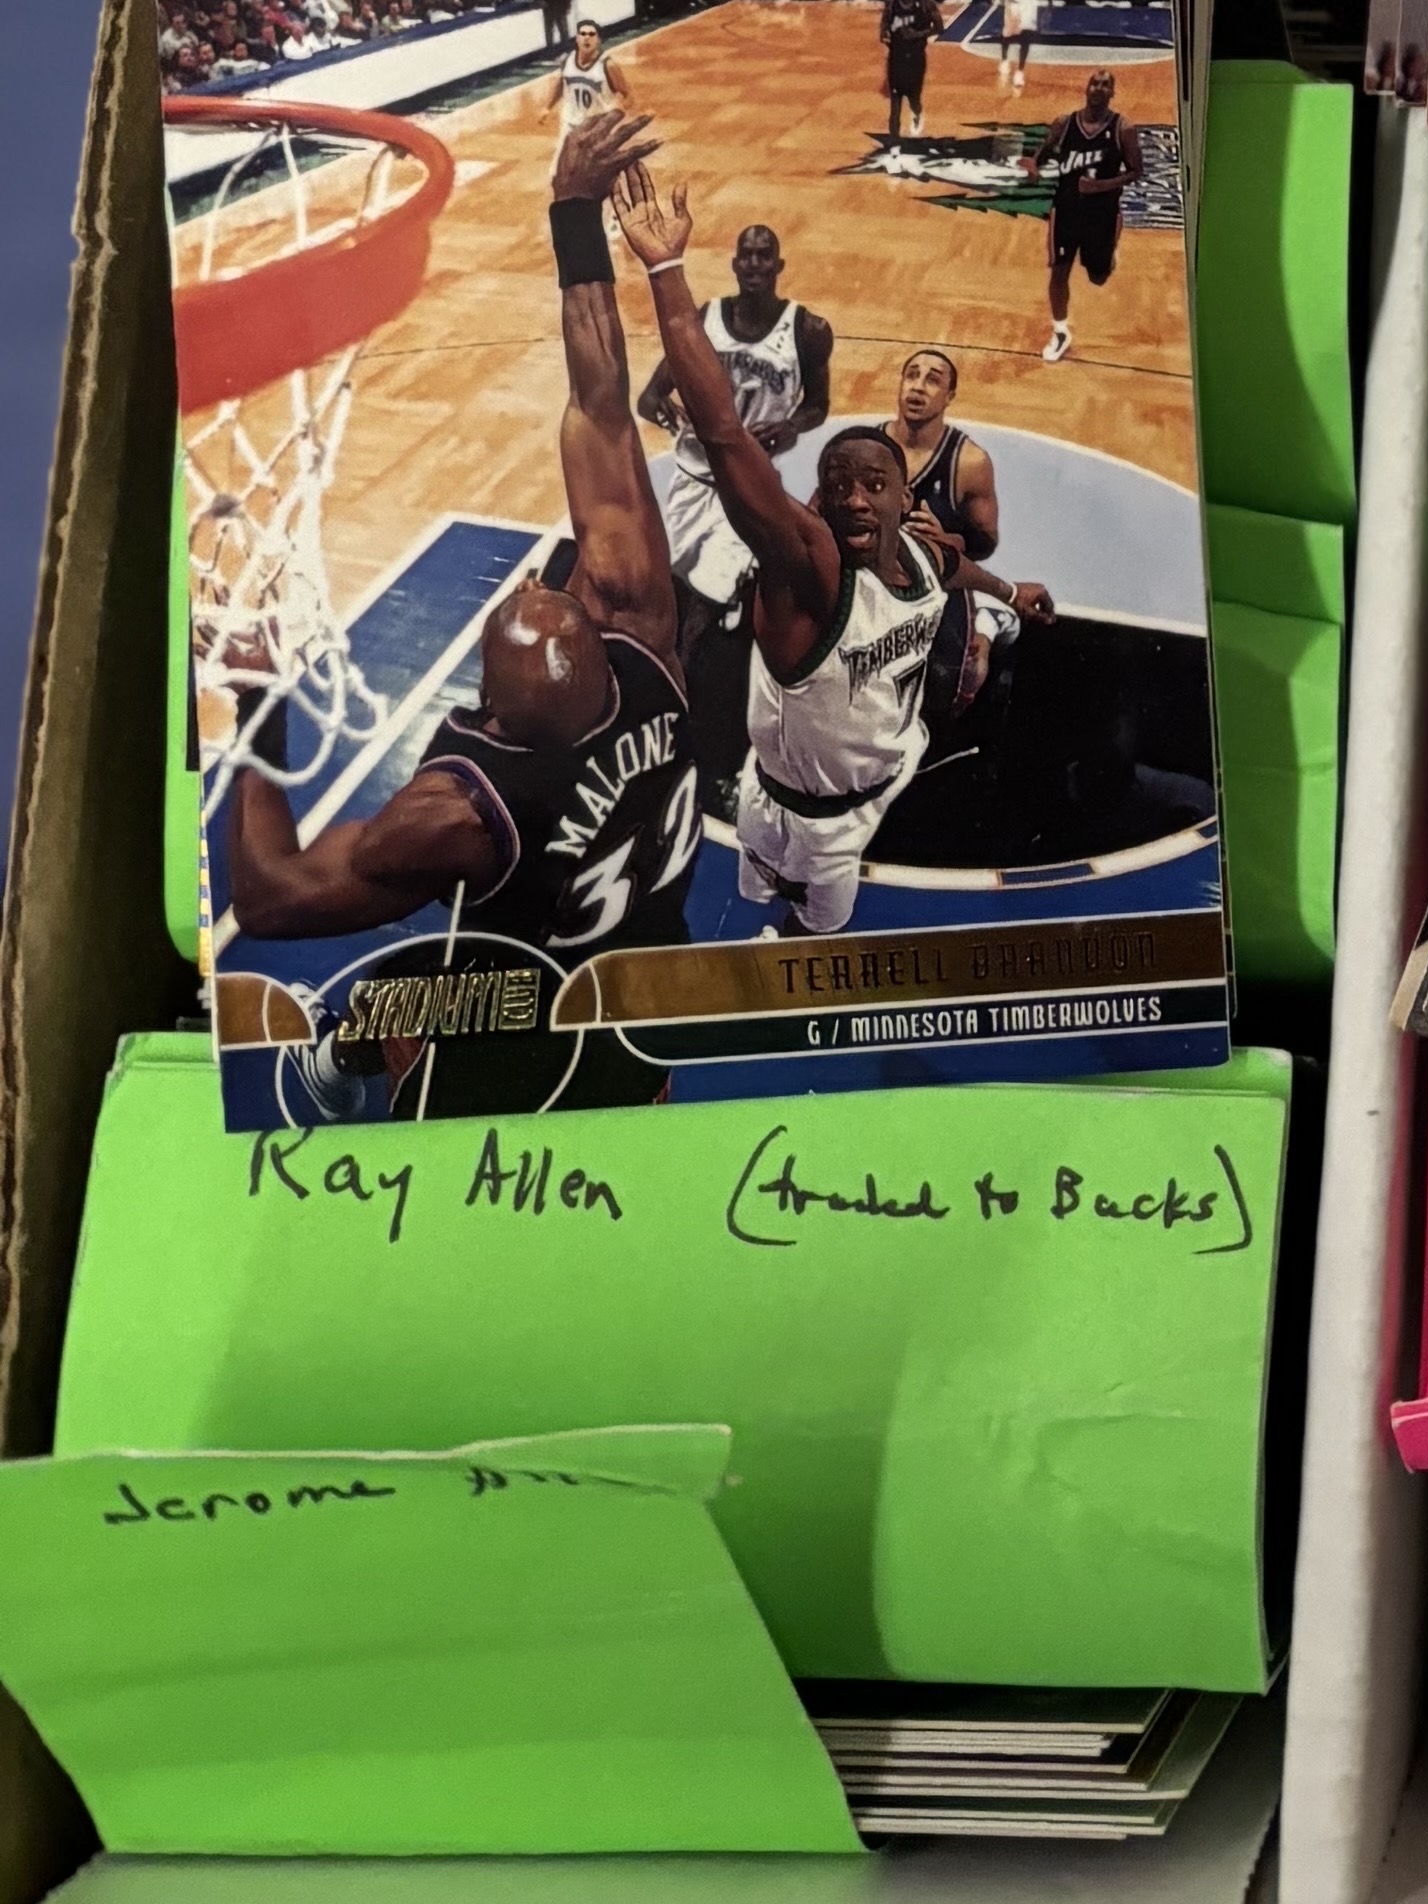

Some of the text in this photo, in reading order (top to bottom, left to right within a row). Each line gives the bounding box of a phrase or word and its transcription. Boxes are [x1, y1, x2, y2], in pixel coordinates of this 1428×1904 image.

[544, 709, 680, 859] MALONE
[806, 1019, 822, 1047] G
[850, 1008, 979, 1043] MINNESOTA
[987, 995, 1164, 1033] TIMBERWOLVES
[247, 1126, 412, 1242] Ray
[465, 1126, 624, 1219] Allen
[103, 1478, 398, 1526] Jerome
